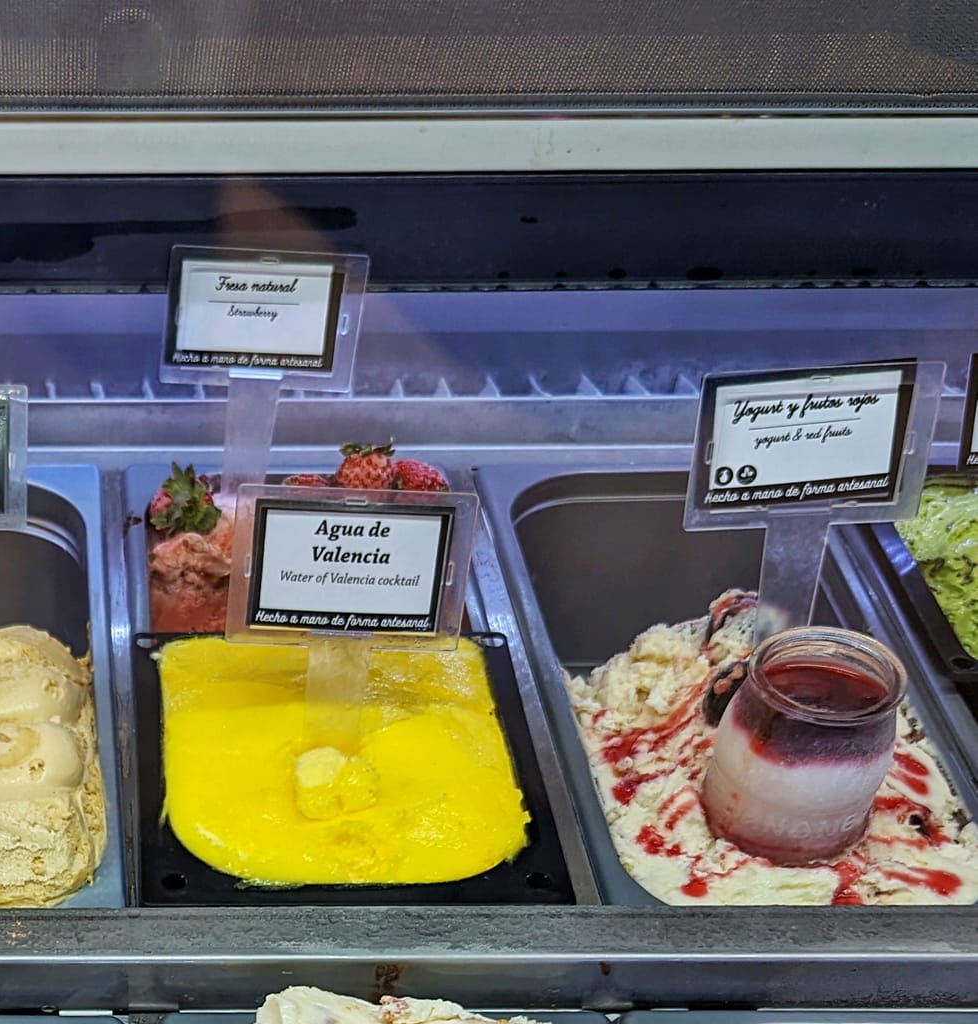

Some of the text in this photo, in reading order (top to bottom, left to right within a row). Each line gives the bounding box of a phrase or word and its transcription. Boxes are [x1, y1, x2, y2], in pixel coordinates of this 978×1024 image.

[215, 276, 299, 293] Fresa natural
[227, 306, 278, 321] Strawberry
[173, 354, 199, 363] Hecho
[237, 356, 249, 365] de
[249, 355, 278, 367] forma
[280, 358, 322, 367] artesanal
[732, 394, 879, 424] Yogurt y frutos rojos
[755, 427, 853, 449] yogurt & red fruits
[705, 491, 739, 504] Hecho
[752, 490, 782, 499] mano
[785, 485, 799, 497] de
[800, 484, 836, 499] forma
[837, 476, 888, 492] artesanal
[315, 520, 390, 541] Agua de
[312, 546, 390, 564] Valencia
[280, 570, 420, 586] Water of Valencia cocktail
[255, 610, 429, 629] Hecho a mano de forma artesanal
